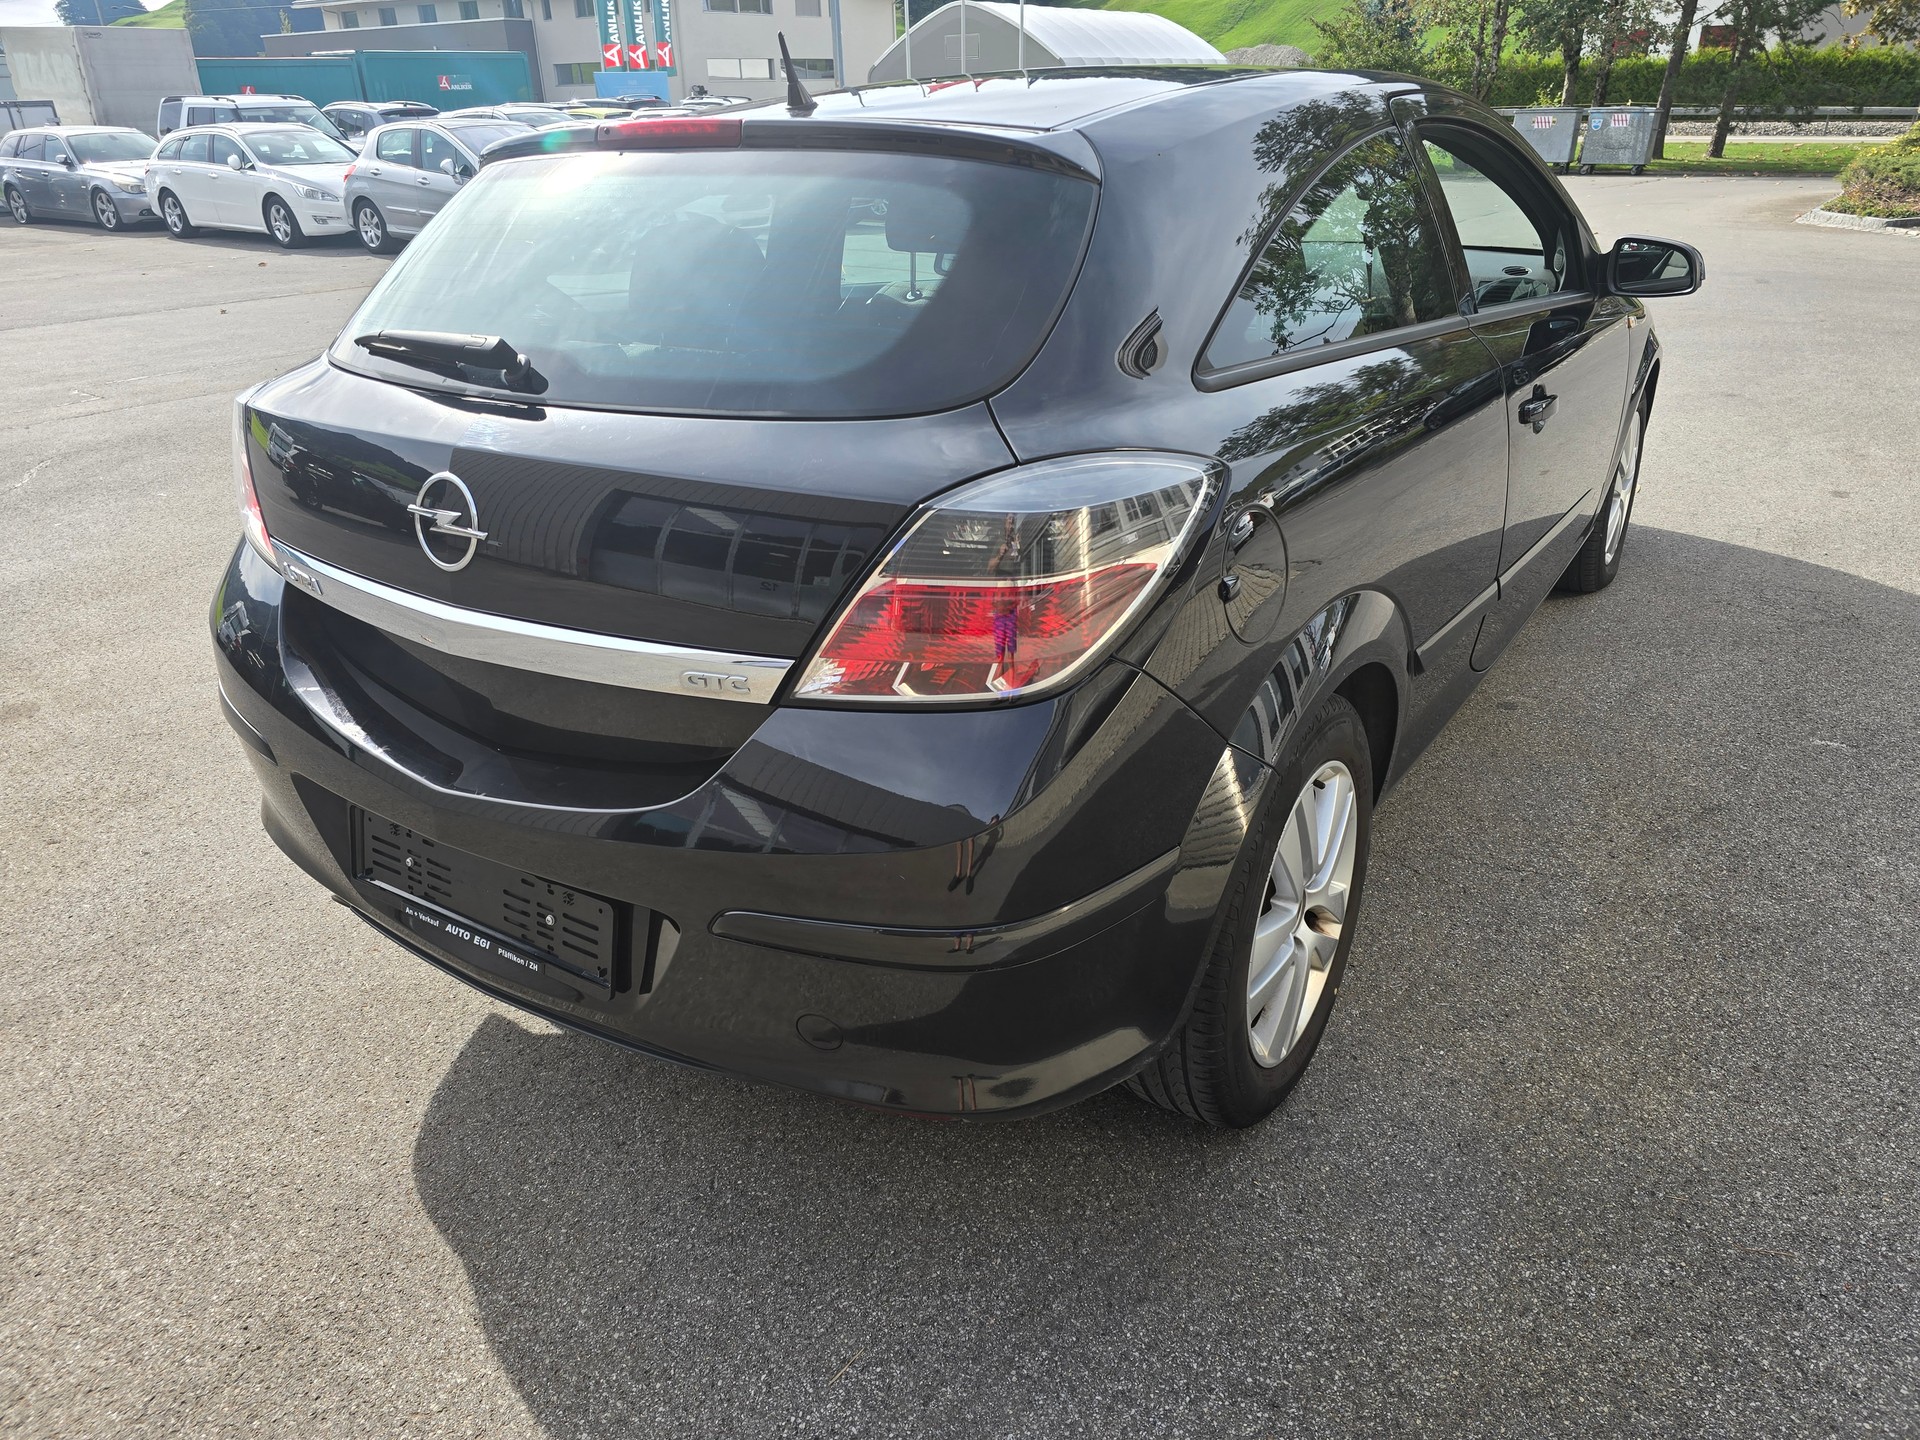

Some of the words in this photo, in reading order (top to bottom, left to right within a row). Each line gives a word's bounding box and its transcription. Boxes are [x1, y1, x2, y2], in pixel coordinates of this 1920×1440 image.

[682, 671, 751, 693] GTC
[405, 906, 414, 916] An
[418, 912, 440, 927] Verkauf
[445, 923, 471, 941] AUTO
[473, 935, 491, 950] EGI
[529, 961, 539, 972] ZH
